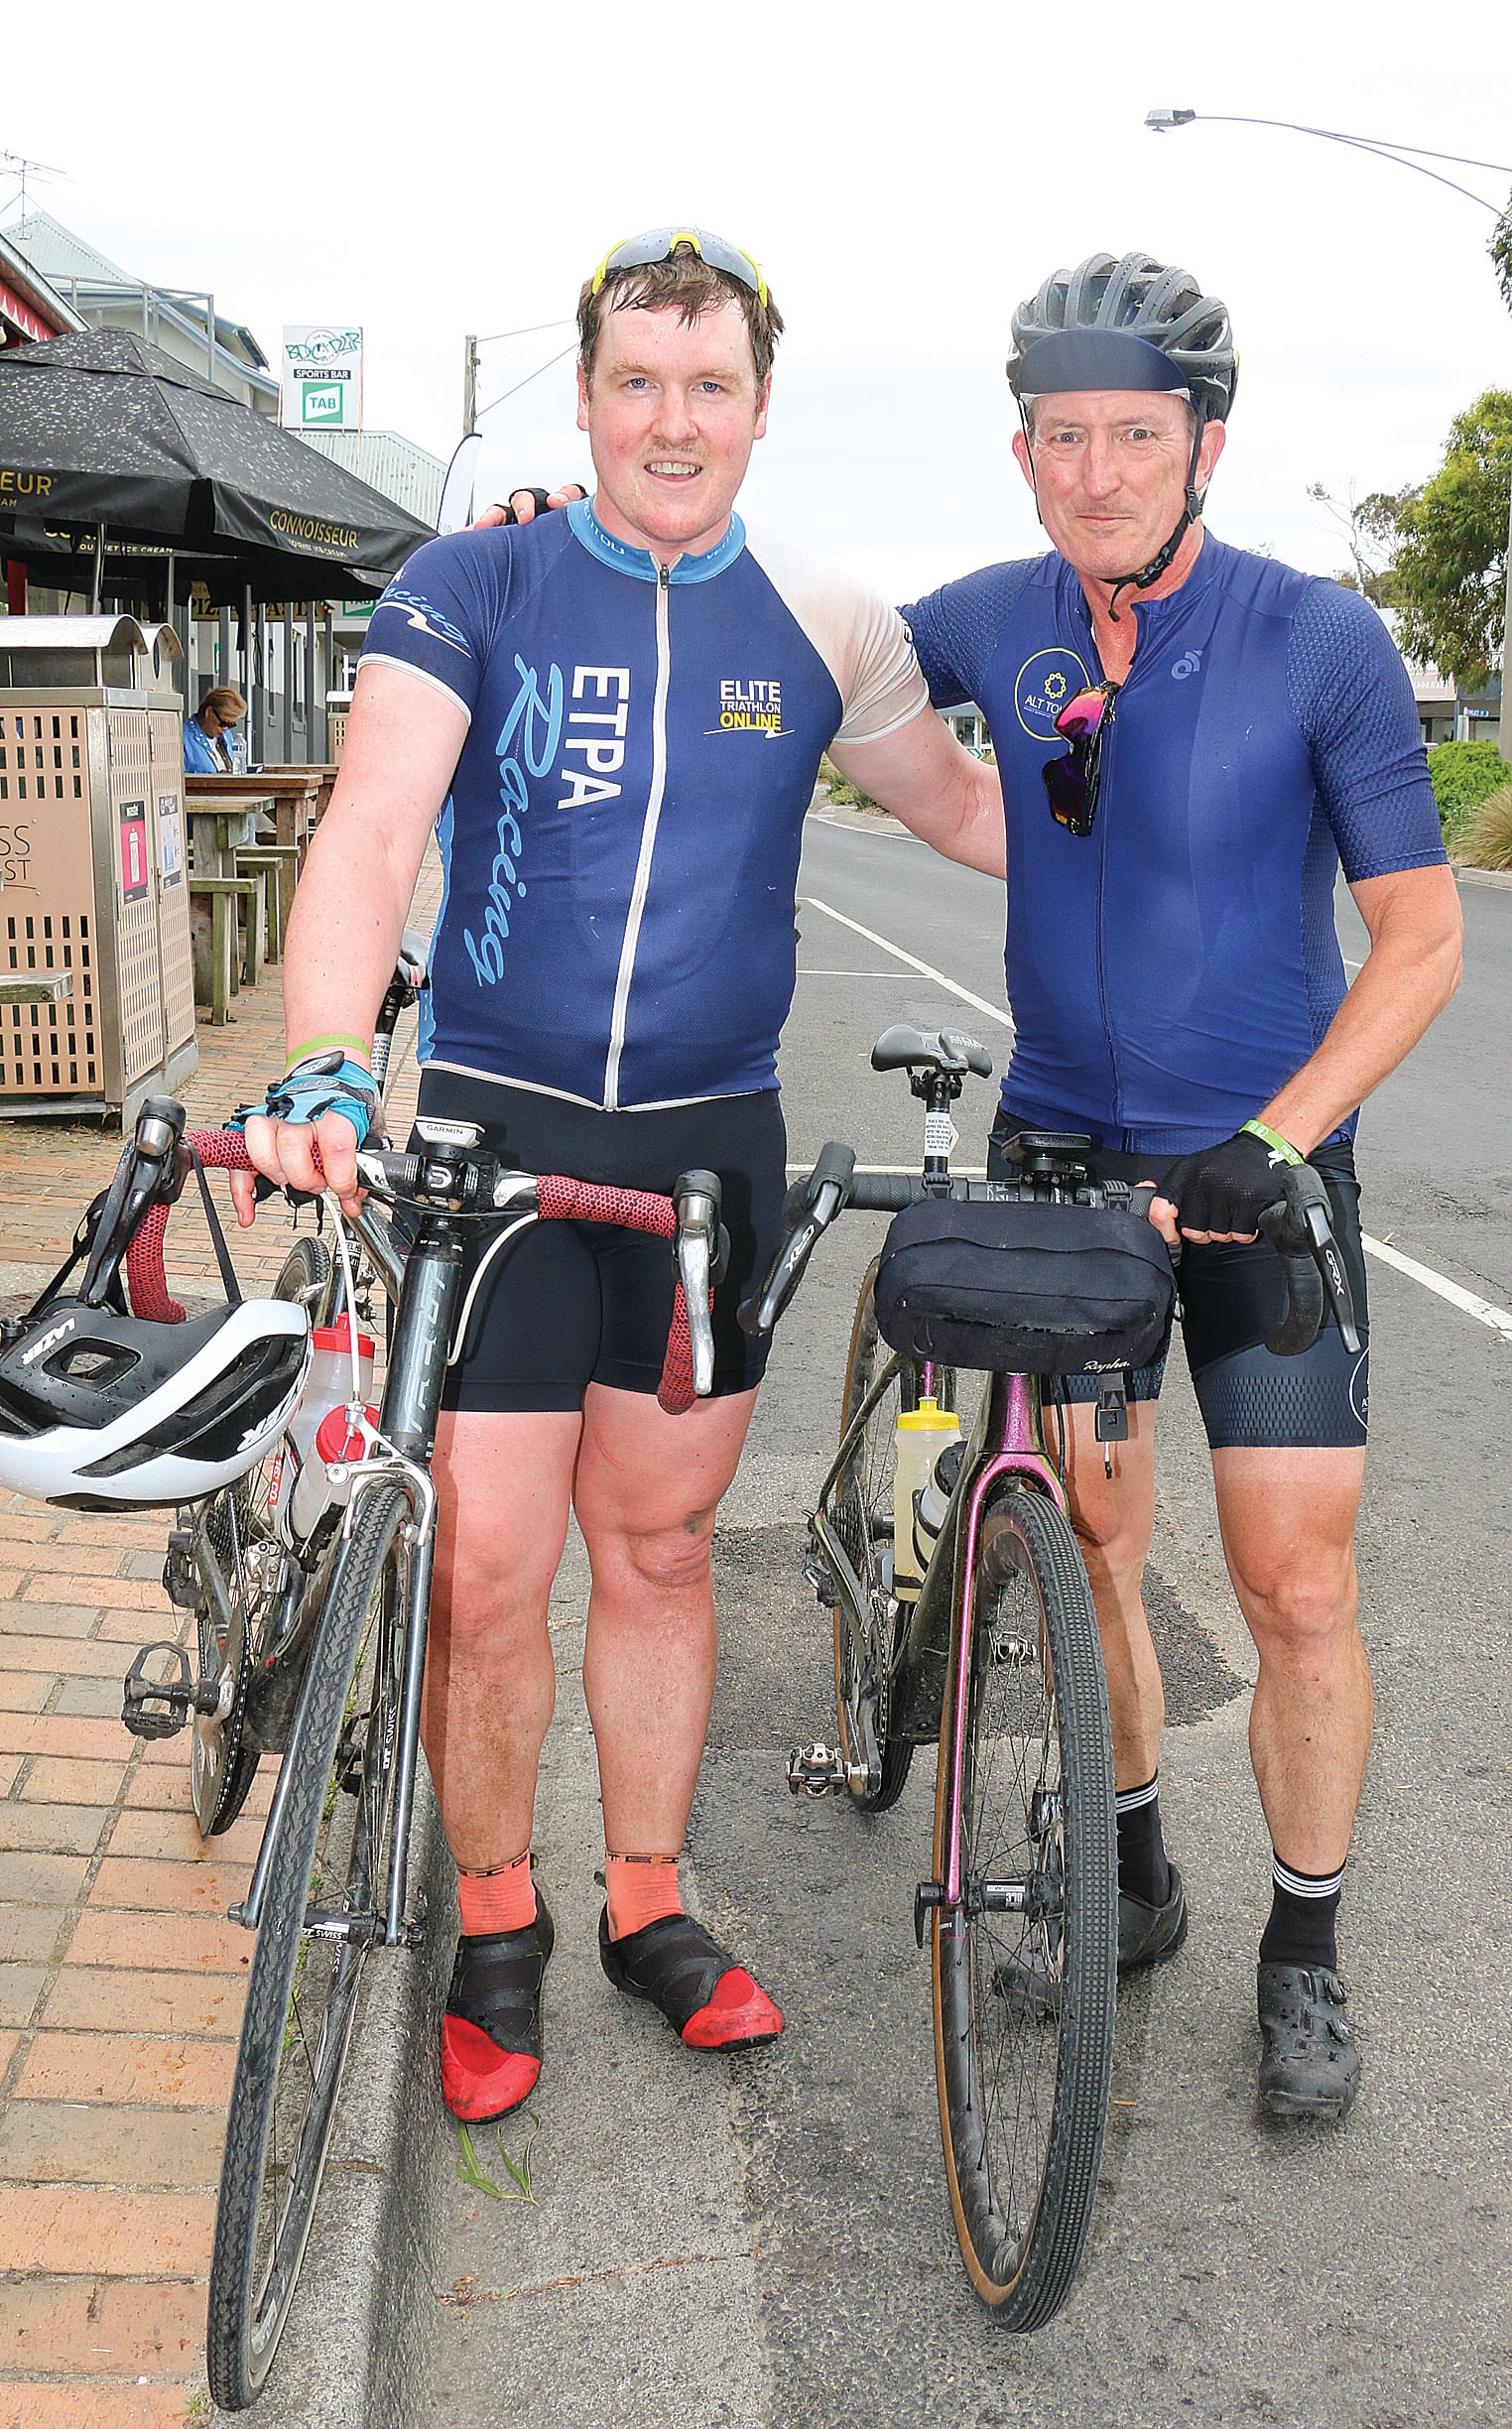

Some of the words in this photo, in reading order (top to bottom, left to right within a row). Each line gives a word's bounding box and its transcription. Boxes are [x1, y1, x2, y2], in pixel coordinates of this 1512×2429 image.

[297, 369, 329, 378] SPORTS
[330, 370, 348, 379] BAR
[310, 397, 336, 409] TAB
[270, 510, 359, 549] CONNOISSEUR
[720, 680, 782, 703] ELITE
[1024, 694, 1045, 709] ALT
[719, 701, 781, 713] TRIATHLON
[719, 711, 782, 731] ONLINE
[557, 664, 631, 811] ETPA
[463, 652, 565, 987] Racing
[427, 1123, 463, 1135] GARMIN
[784, 1223, 815, 1272] GRX
[1324, 1248, 1345, 1296] GRX
[385, 1705, 398, 1744] SWISS
[315, 1929, 342, 1940] SWISS
